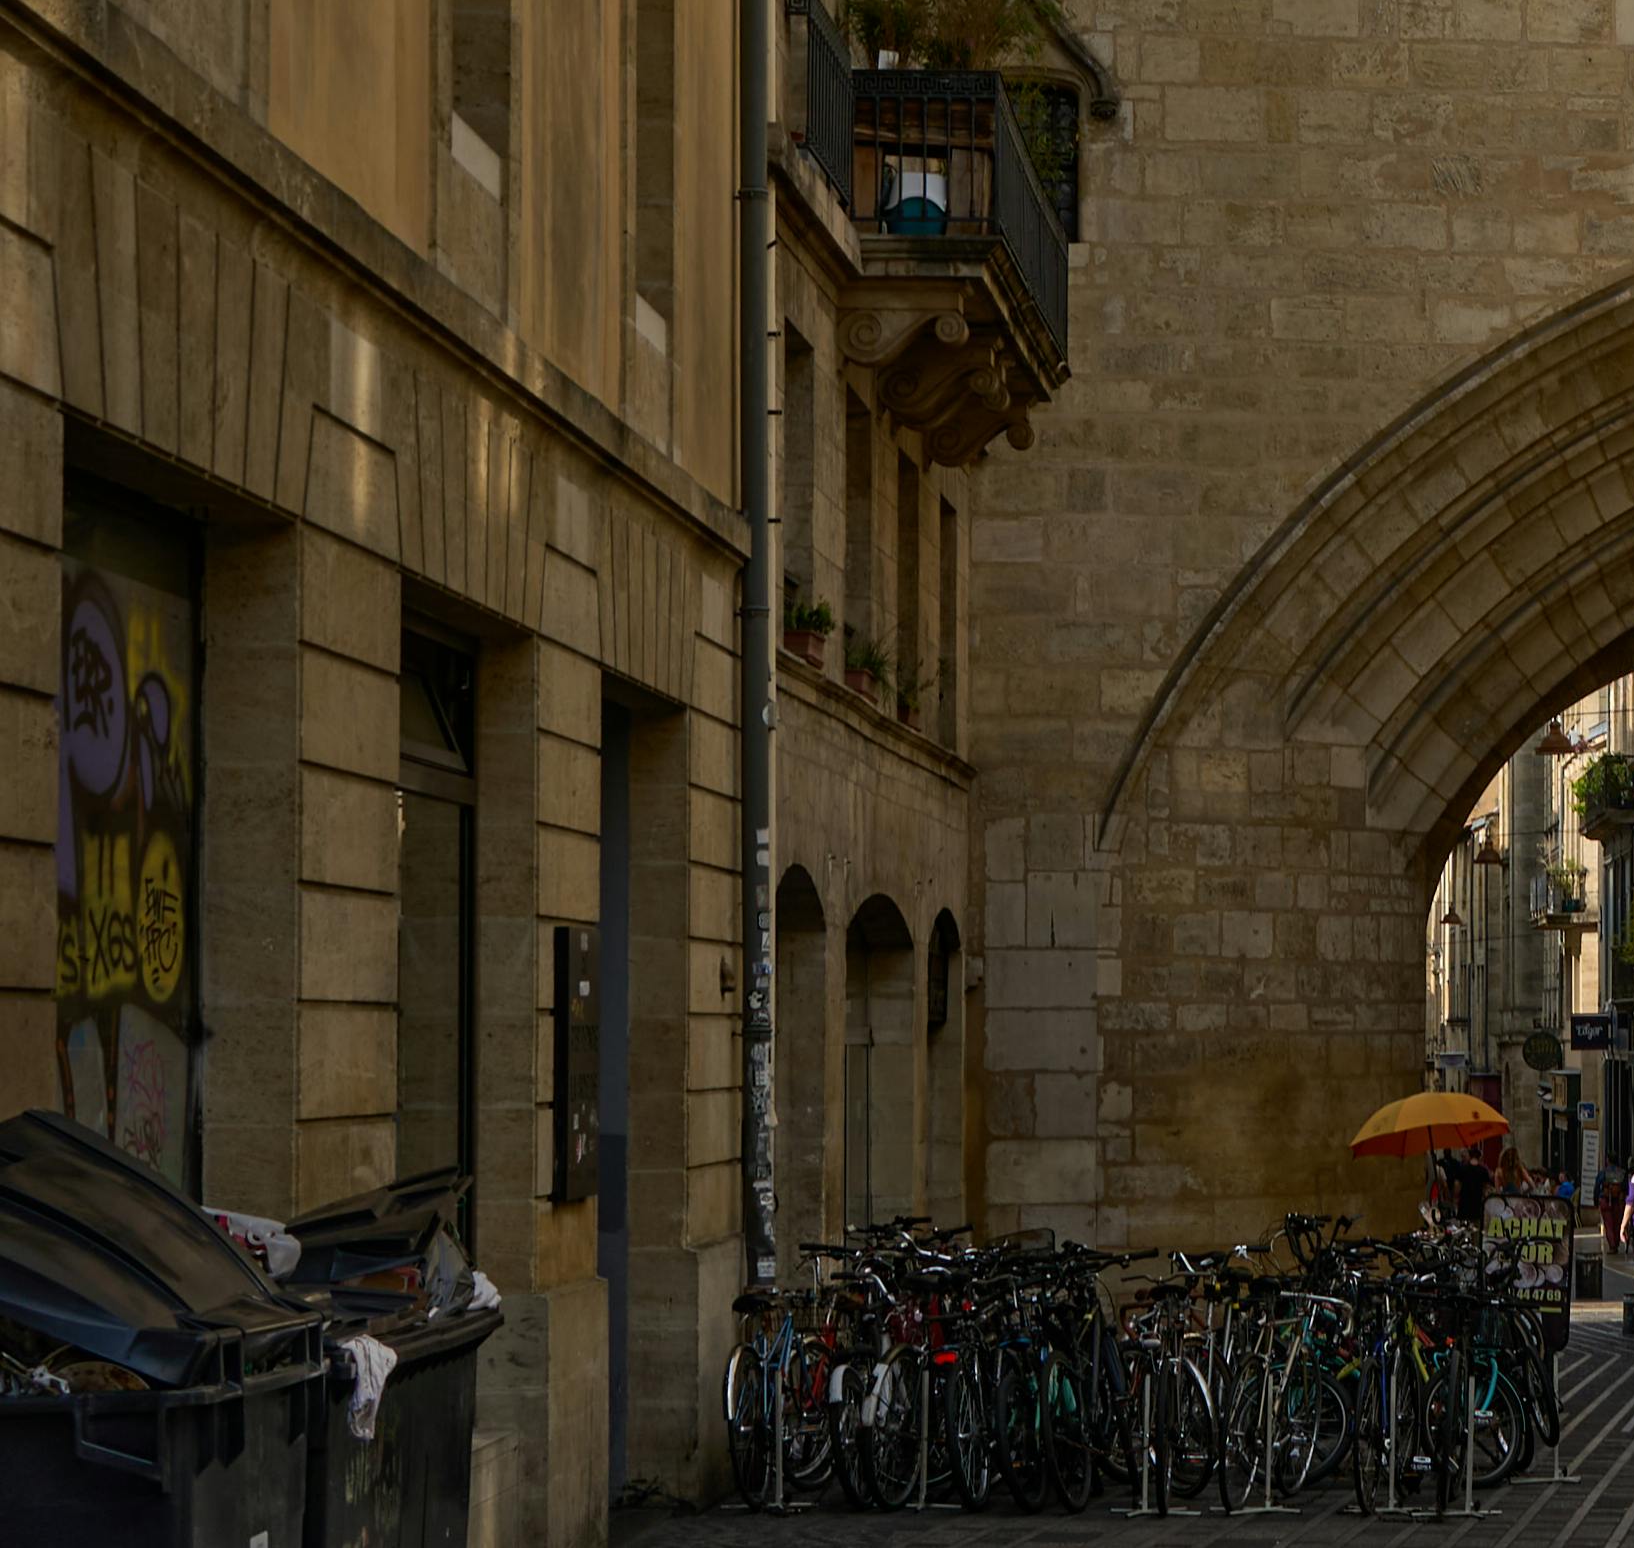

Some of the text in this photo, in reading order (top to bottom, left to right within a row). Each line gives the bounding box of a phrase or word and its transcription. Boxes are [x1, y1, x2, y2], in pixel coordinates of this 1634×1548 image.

[1487, 1217, 1567, 1239] ACHAT
[1532, 1289, 1545, 1301] 47
[1546, 1289, 1562, 1302] 69
